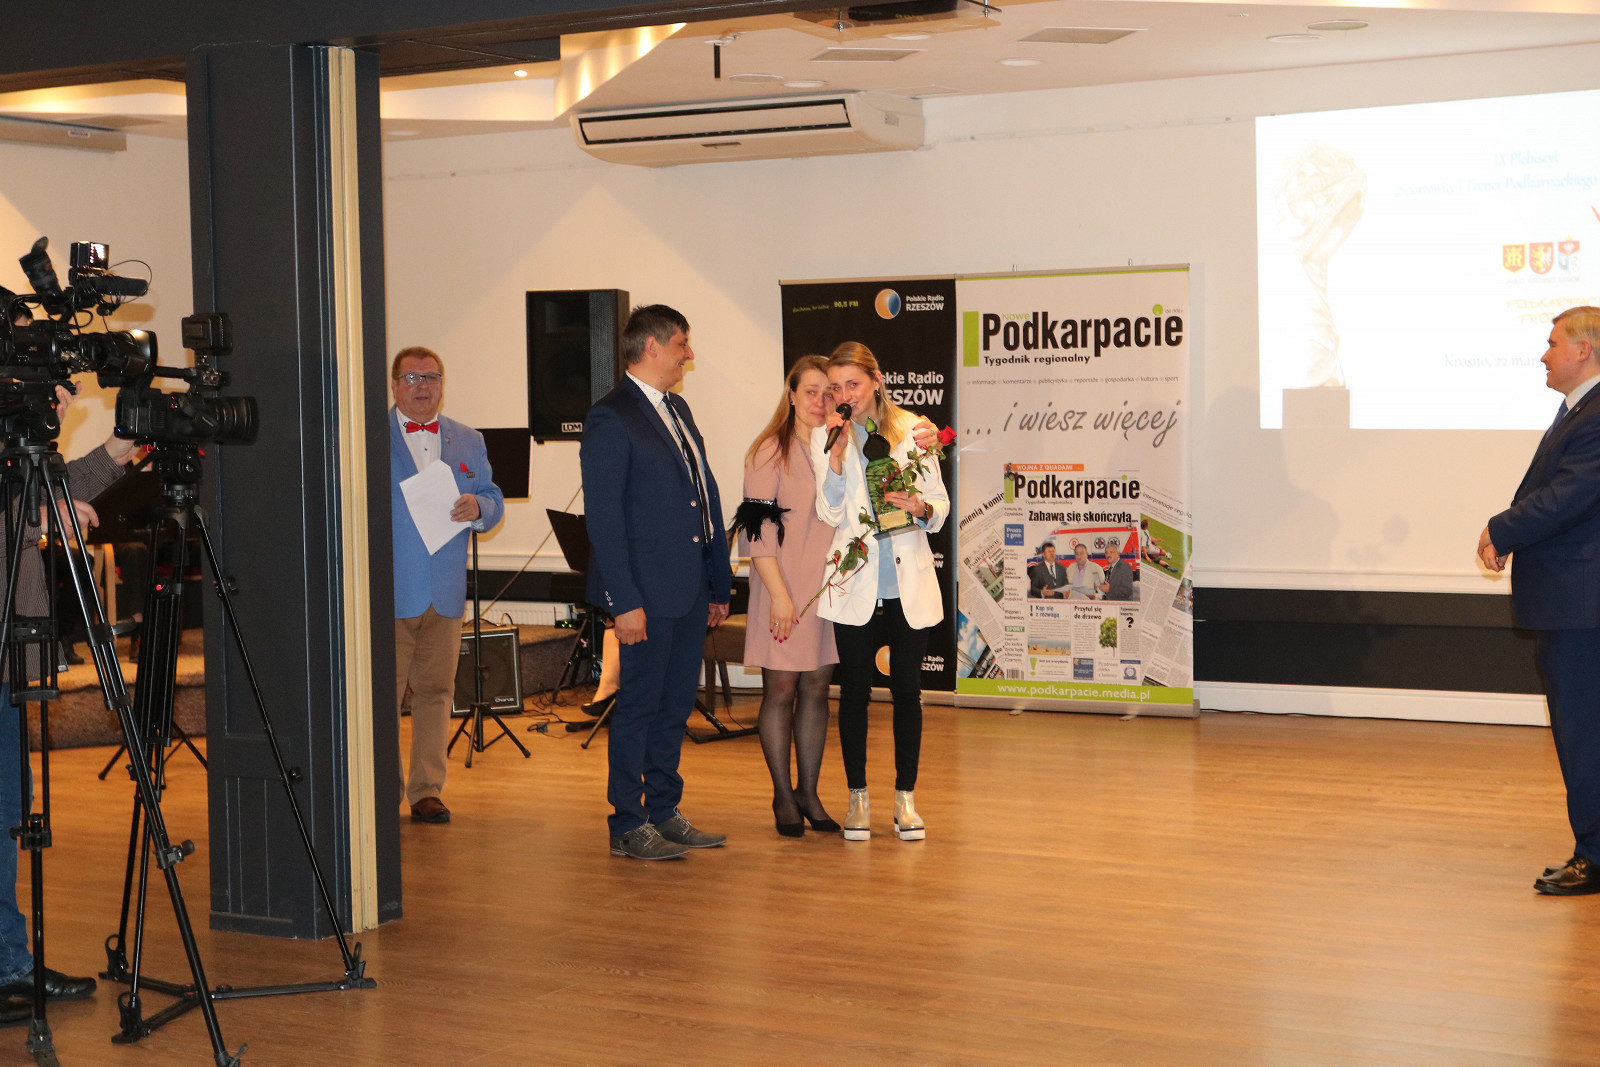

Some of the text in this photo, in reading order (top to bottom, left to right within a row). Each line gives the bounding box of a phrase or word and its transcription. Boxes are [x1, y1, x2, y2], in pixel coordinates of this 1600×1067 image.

[1510, 150, 1559, 168] Plebiscyt
[1466, 178, 1502, 192] Trener
[1505, 171, 1598, 192] Podkarpackiego
[927, 294, 944, 302] Radio
[906, 301, 944, 311] RZESZÓW
[982, 304, 1184, 358] Podkarpacie
[984, 353, 1091, 367] Tygodnik regionalny
[882, 371, 945, 385] skie Radio
[972, 378, 997, 386] informacje
[1038, 377, 1068, 386] publicystyka
[1074, 376, 1098, 384] reportaże
[1105, 376, 1134, 384] gospodarka
[1164, 375, 1179, 383] sport
[1003, 402, 1018, 432] i
[1019, 402, 1087, 432] wiesz
[1093, 400, 1181, 448] więcej
[1014, 474, 1141, 504] Podkarpacie
[1028, 510, 1065, 522] Zabawa
[1067, 510, 1081, 524] się
[920, 662, 945, 672] SZÓW
[997, 685, 1151, 702] www.podkarpacie.media.pl
